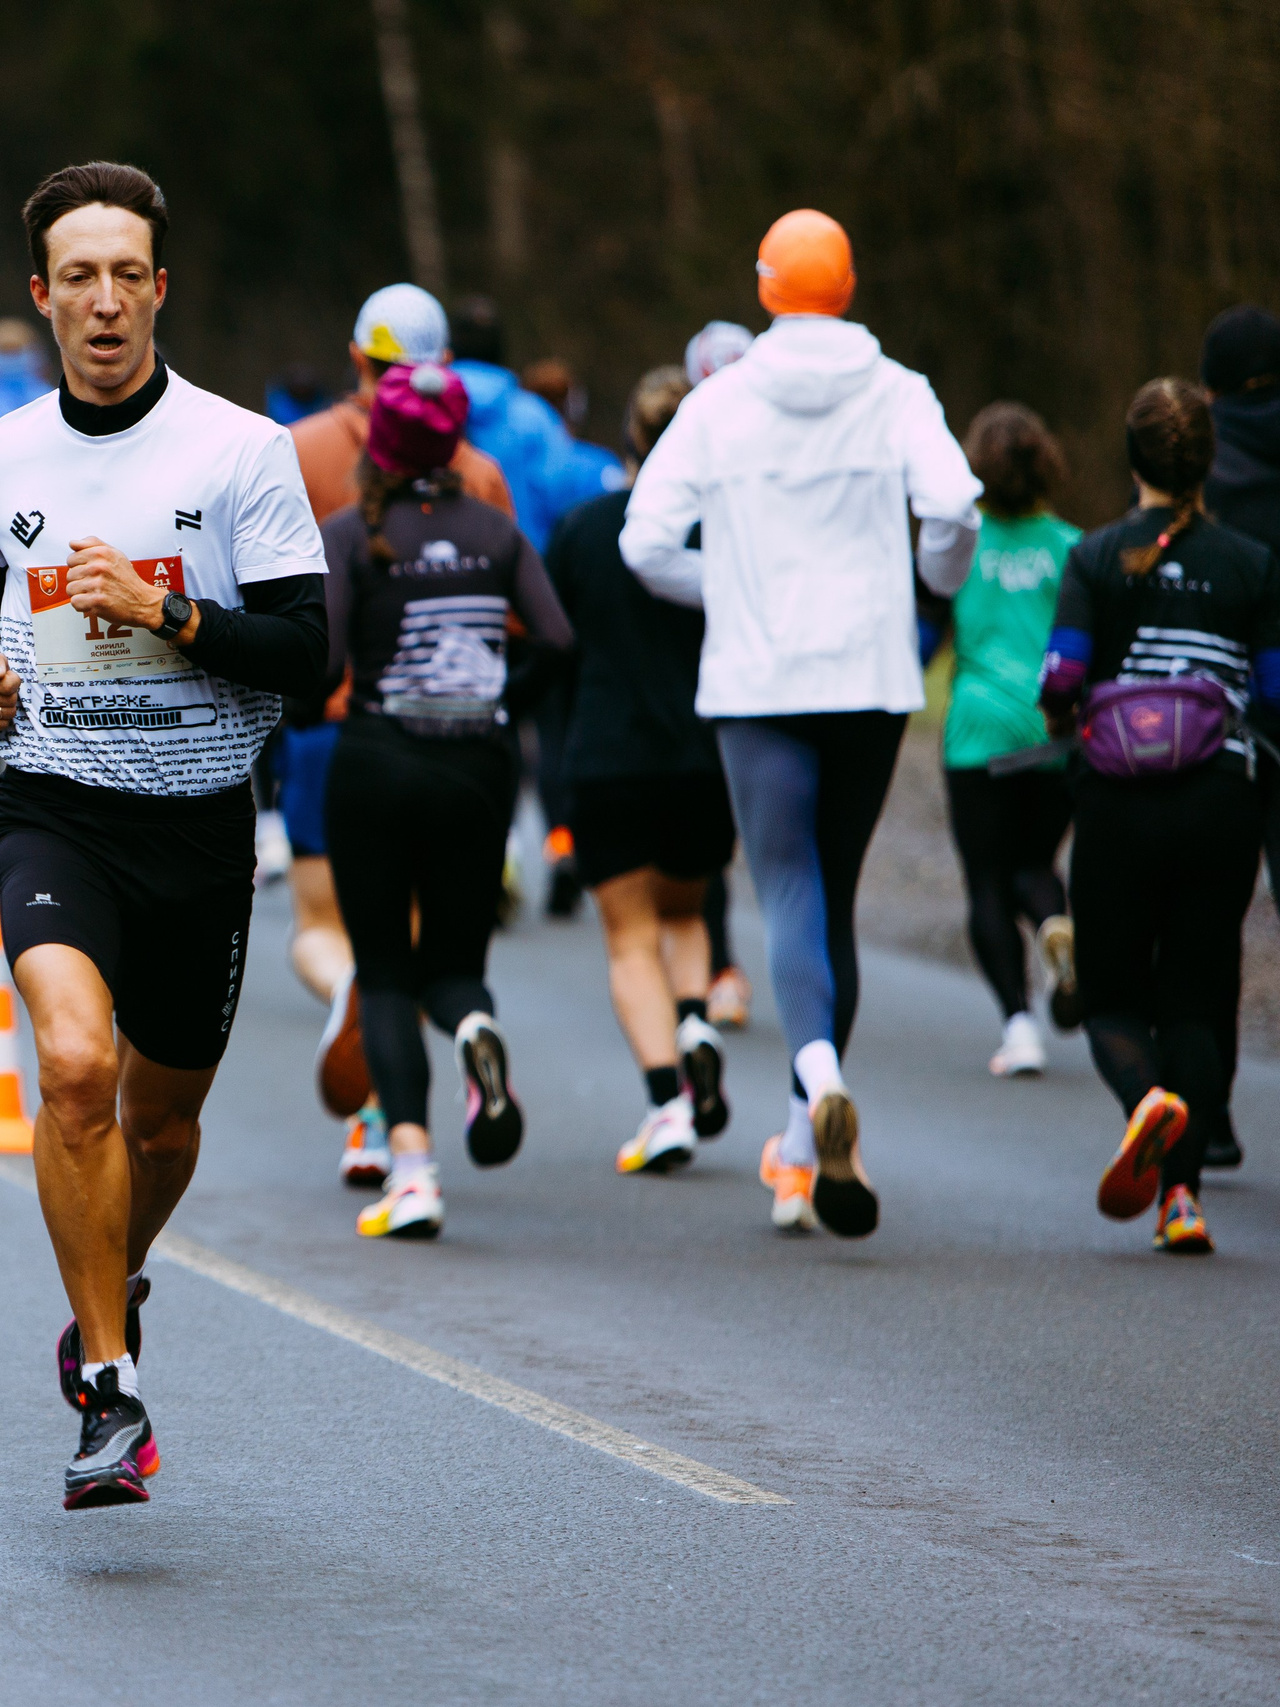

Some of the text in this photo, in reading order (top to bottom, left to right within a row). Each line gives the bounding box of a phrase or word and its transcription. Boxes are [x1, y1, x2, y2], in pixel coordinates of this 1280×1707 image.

[154, 578, 171, 587] 21.1
[95, 642, 125, 650] КИРИЛЛ
[90, 647, 131, 657] ЯСНИЦКИЙ
